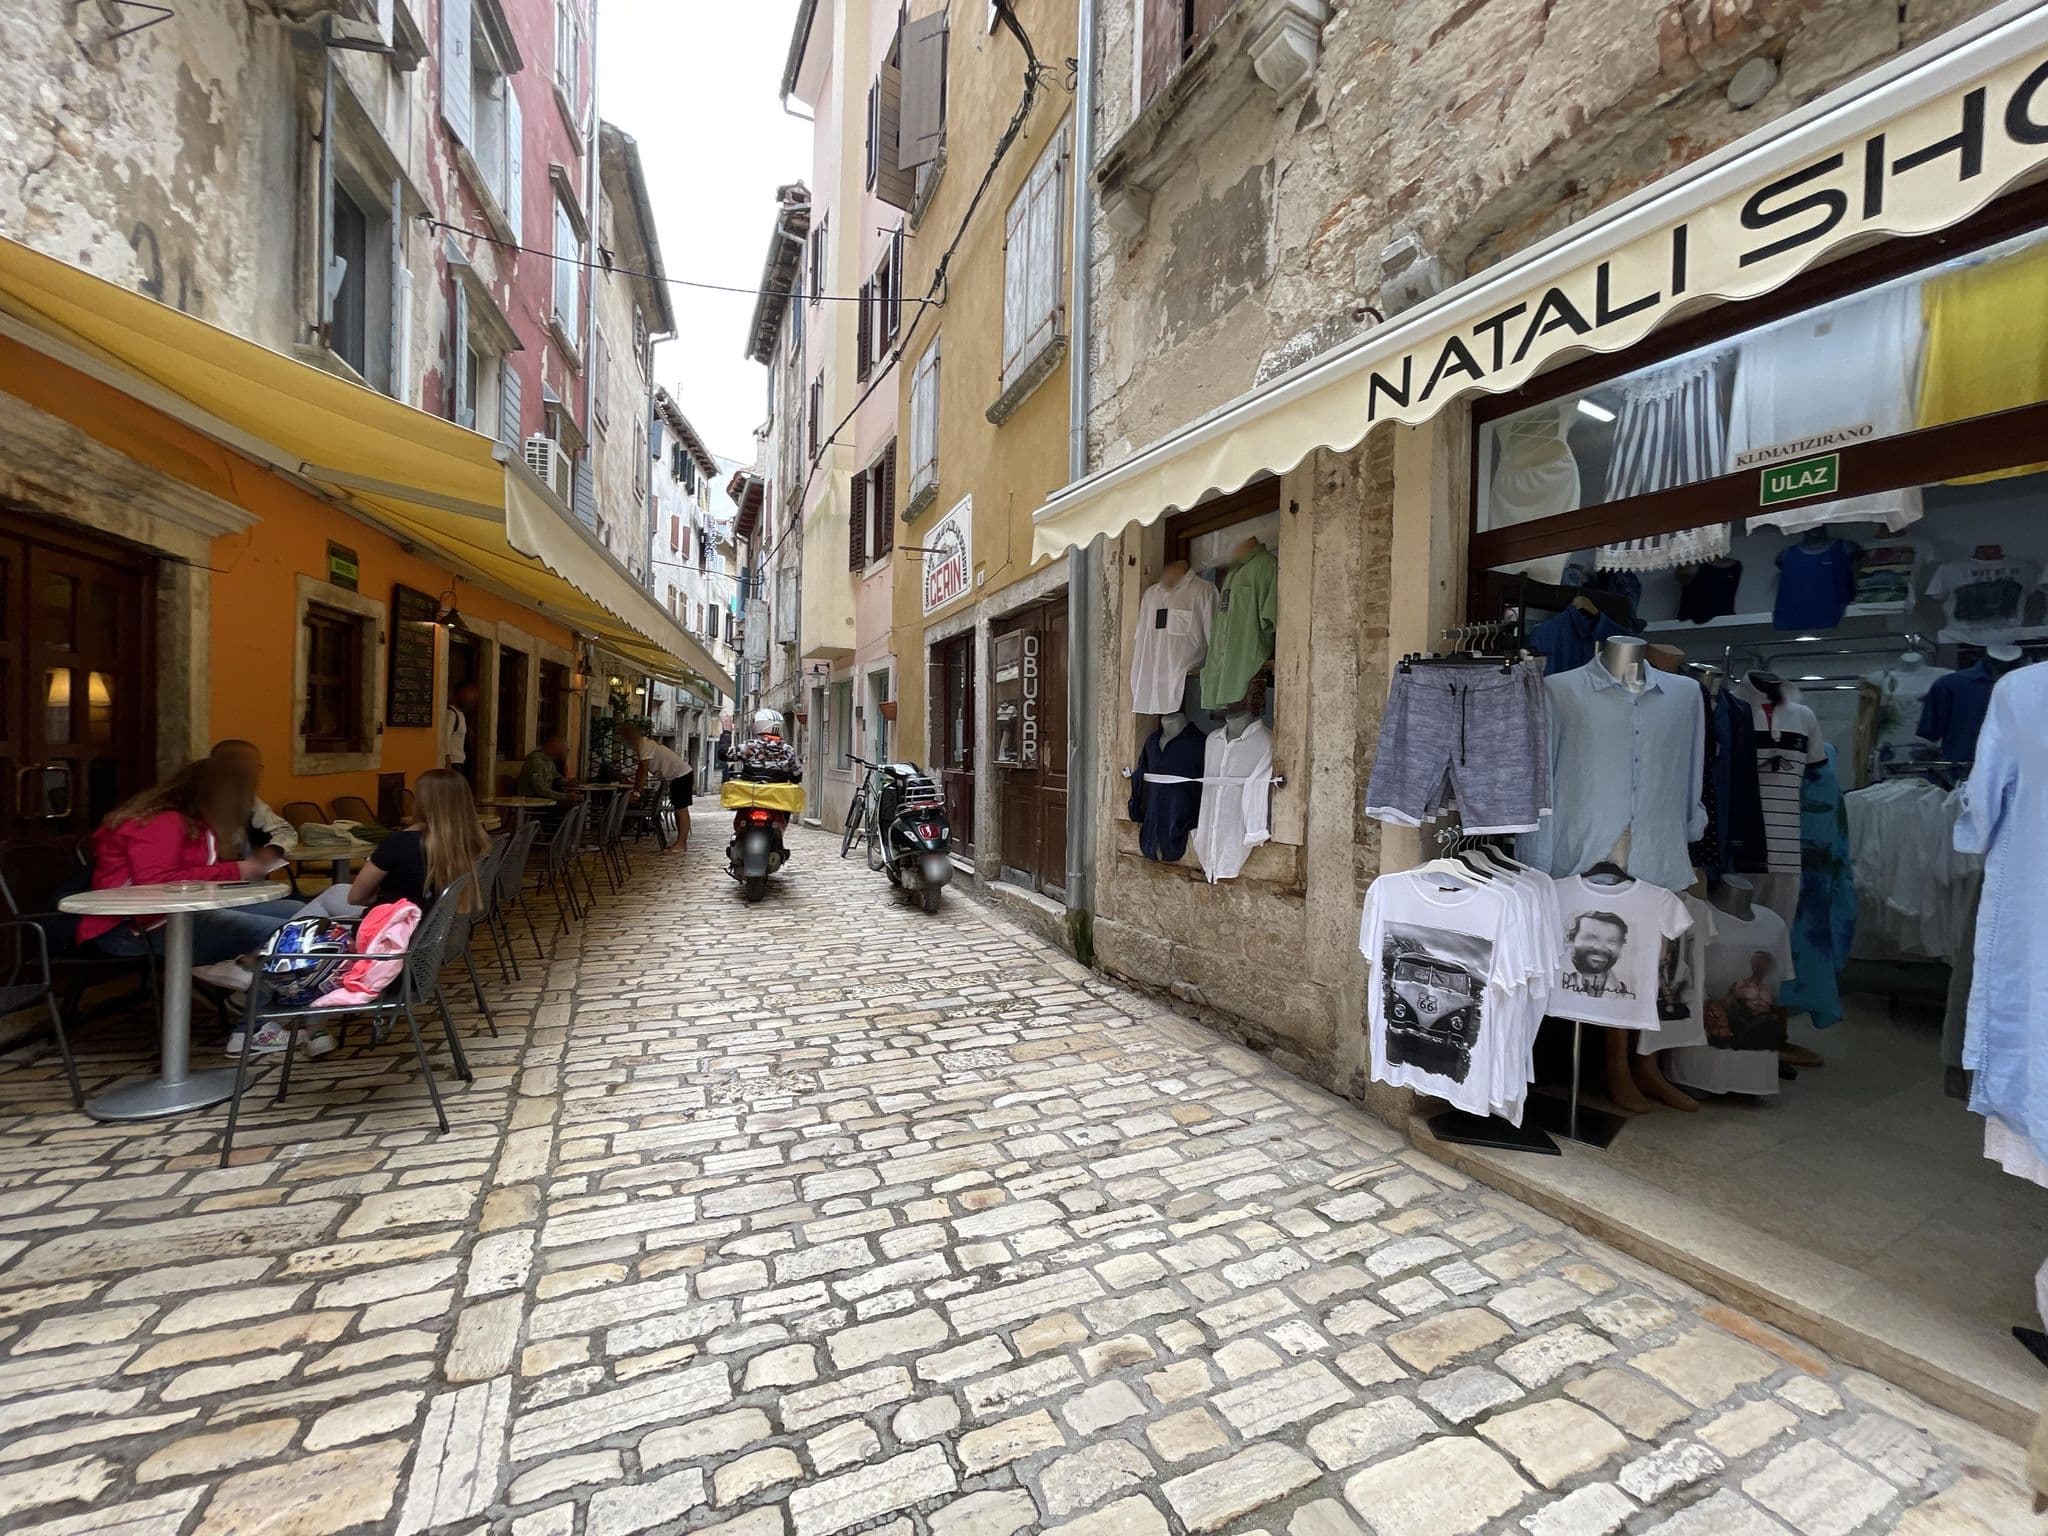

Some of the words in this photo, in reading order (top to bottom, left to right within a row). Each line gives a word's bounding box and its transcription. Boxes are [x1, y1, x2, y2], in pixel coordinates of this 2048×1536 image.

[1368, 224, 1688, 421] NATALI
[1736, 423, 1874, 467] KLIMATIZIRANO
[1771, 466, 1829, 493] ULAZ
[1022, 635, 1039, 761] OBUCAR
[1419, 1000, 1435, 1012] 66
